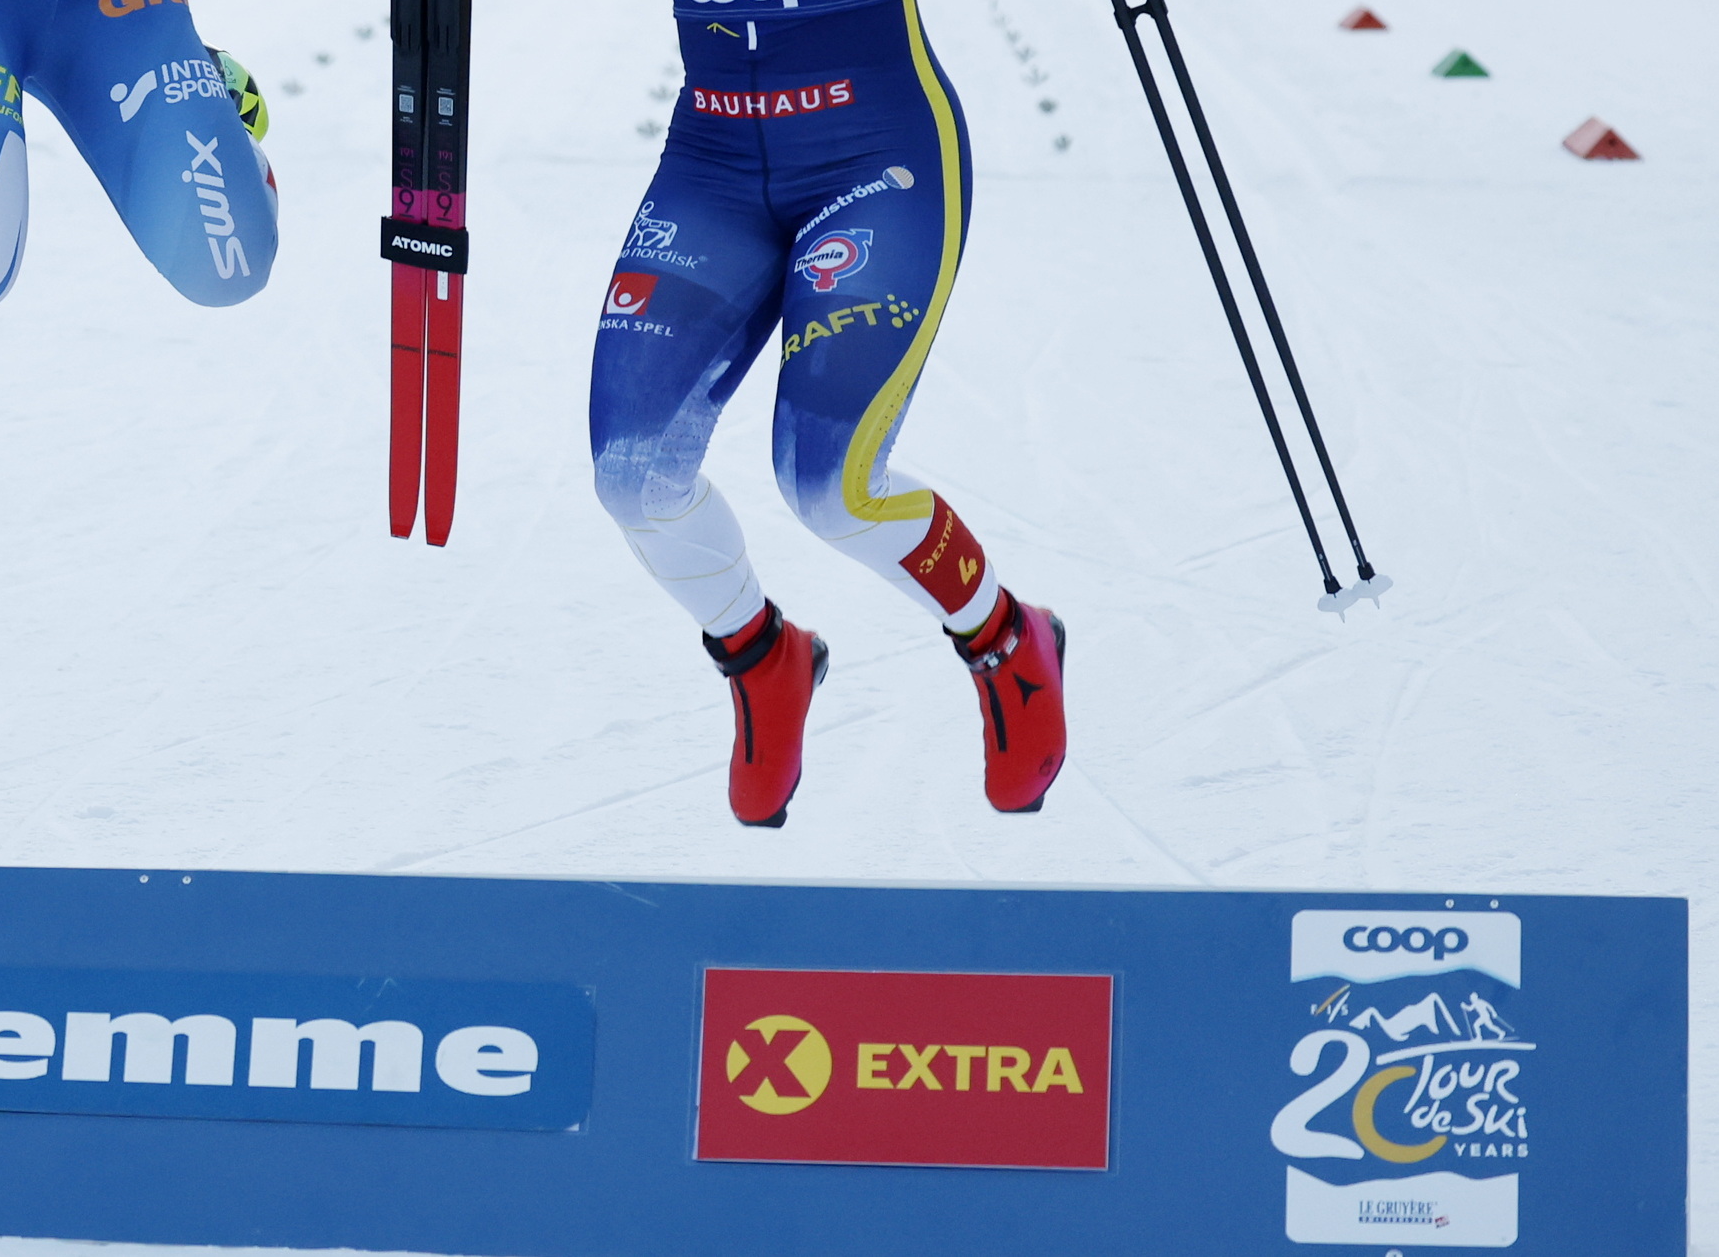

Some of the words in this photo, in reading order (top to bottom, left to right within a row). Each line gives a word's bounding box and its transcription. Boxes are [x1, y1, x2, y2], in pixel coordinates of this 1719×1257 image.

[164, 79, 228, 104] SPORT
[694, 82, 851, 116] BAUHAUS
[391, 235, 453, 257] ATOMIC
[631, 246, 698, 269] nordisk
[794, 249, 845, 273] Thermia
[633, 320, 674, 337] SPEL
[959, 556, 978, 586] 4
[1343, 926, 1469, 961] coop
[857, 1043, 1084, 1094] EXTRA
[1410, 1100, 1452, 1133] de
[1453, 1142, 1529, 1158] YEARS
[1358, 1200, 1375, 1215] LE
[1375, 1199, 1434, 1216] GRUYÈRE
